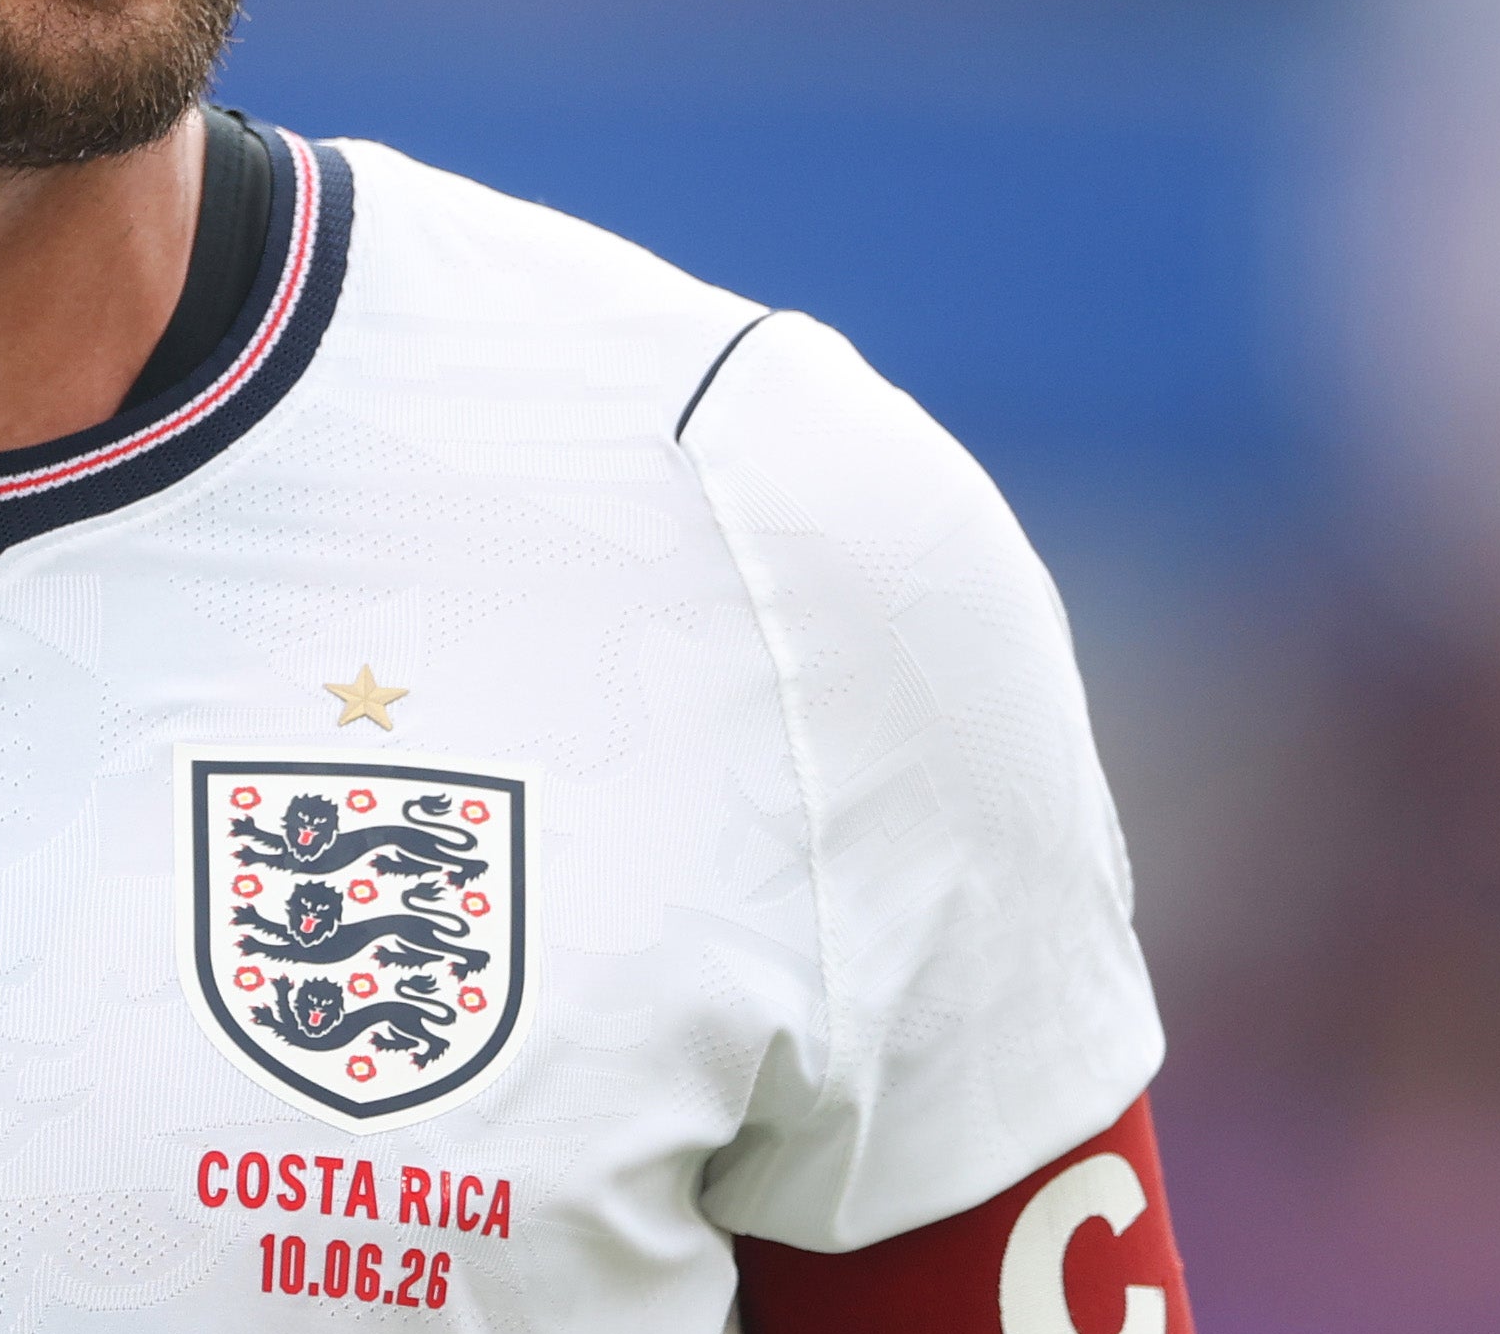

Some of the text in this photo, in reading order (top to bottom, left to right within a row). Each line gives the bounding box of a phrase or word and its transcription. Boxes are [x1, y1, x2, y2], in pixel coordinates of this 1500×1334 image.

[198, 1151, 510, 1239] COSTA RICA
[260, 1234, 452, 1309] 10.06.26
